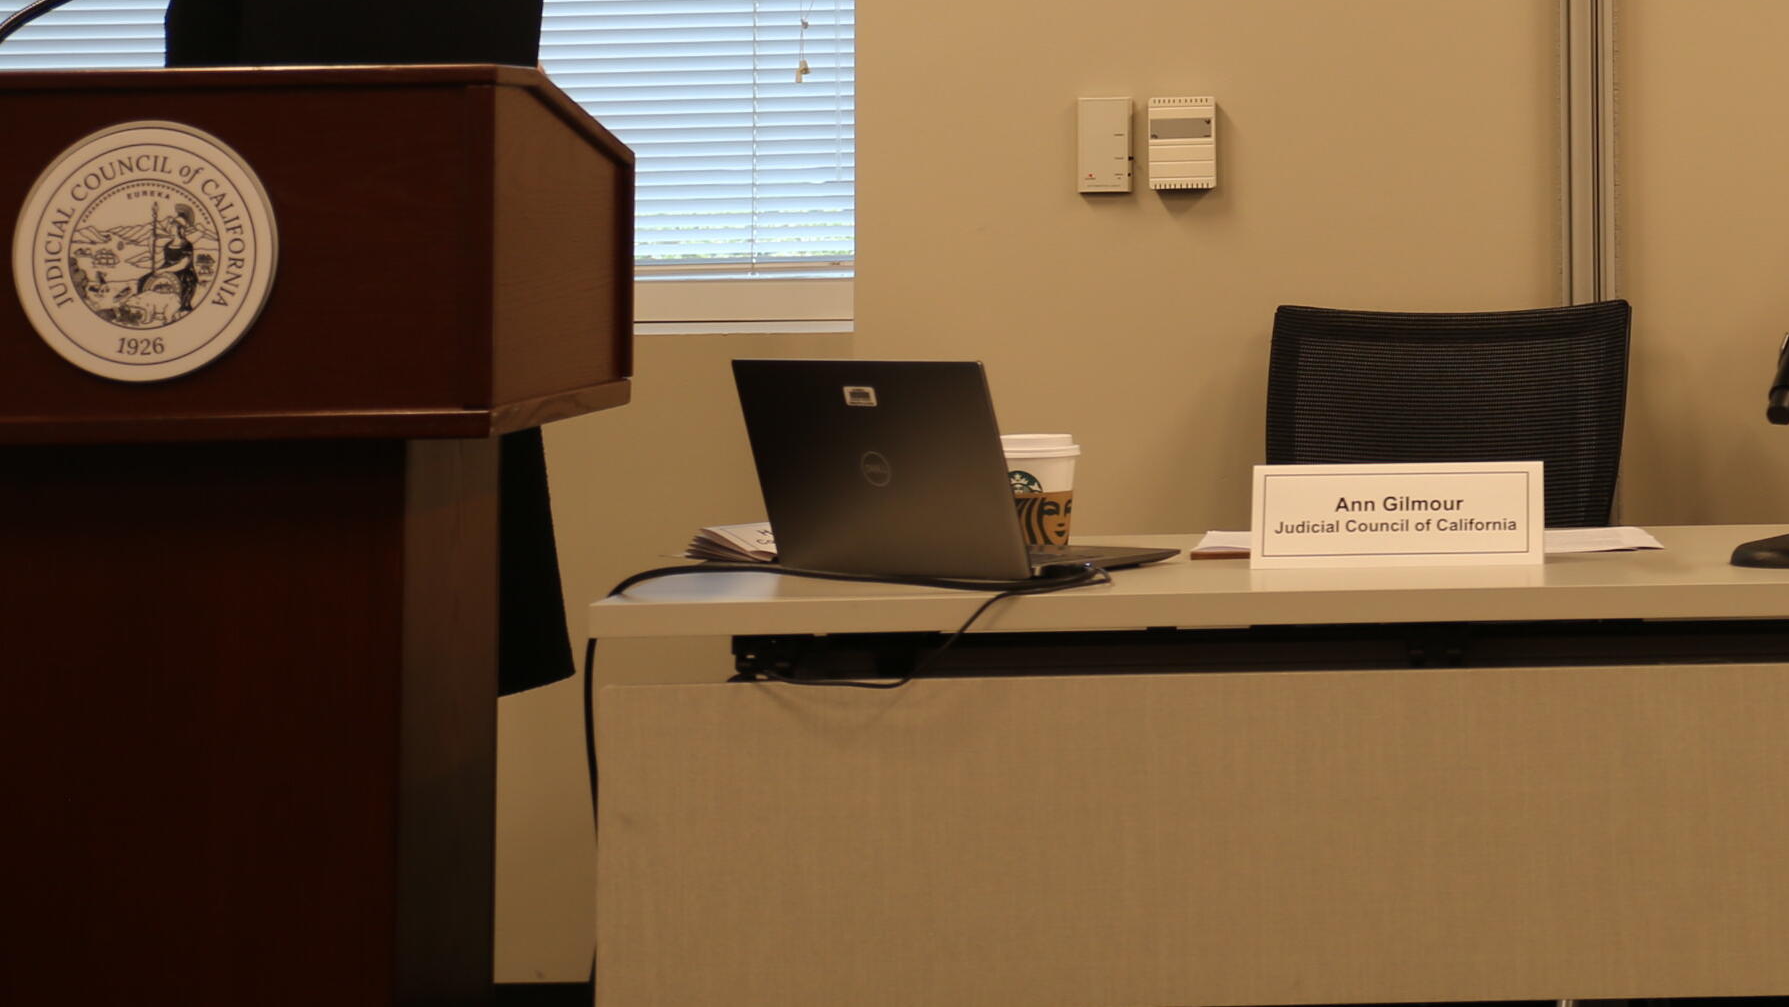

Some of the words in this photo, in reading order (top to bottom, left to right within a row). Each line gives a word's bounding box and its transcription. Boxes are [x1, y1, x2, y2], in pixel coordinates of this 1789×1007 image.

[126, 190, 172, 201] EUREKA
[44, 206, 76, 309] JUDICIAL
[70, 154, 172, 202] COUNCIL
[177, 164, 205, 185] of
[200, 178, 246, 309] CALIFORNIA
[116, 336, 165, 356] 1926
[1334, 496, 1376, 513] Ann
[1382, 495, 1465, 512] Gilmour
[1274, 519, 1340, 535] Judicial
[1344, 518, 1410, 533] Council
[1414, 518, 1432, 532] of
[1436, 517, 1517, 532] California
